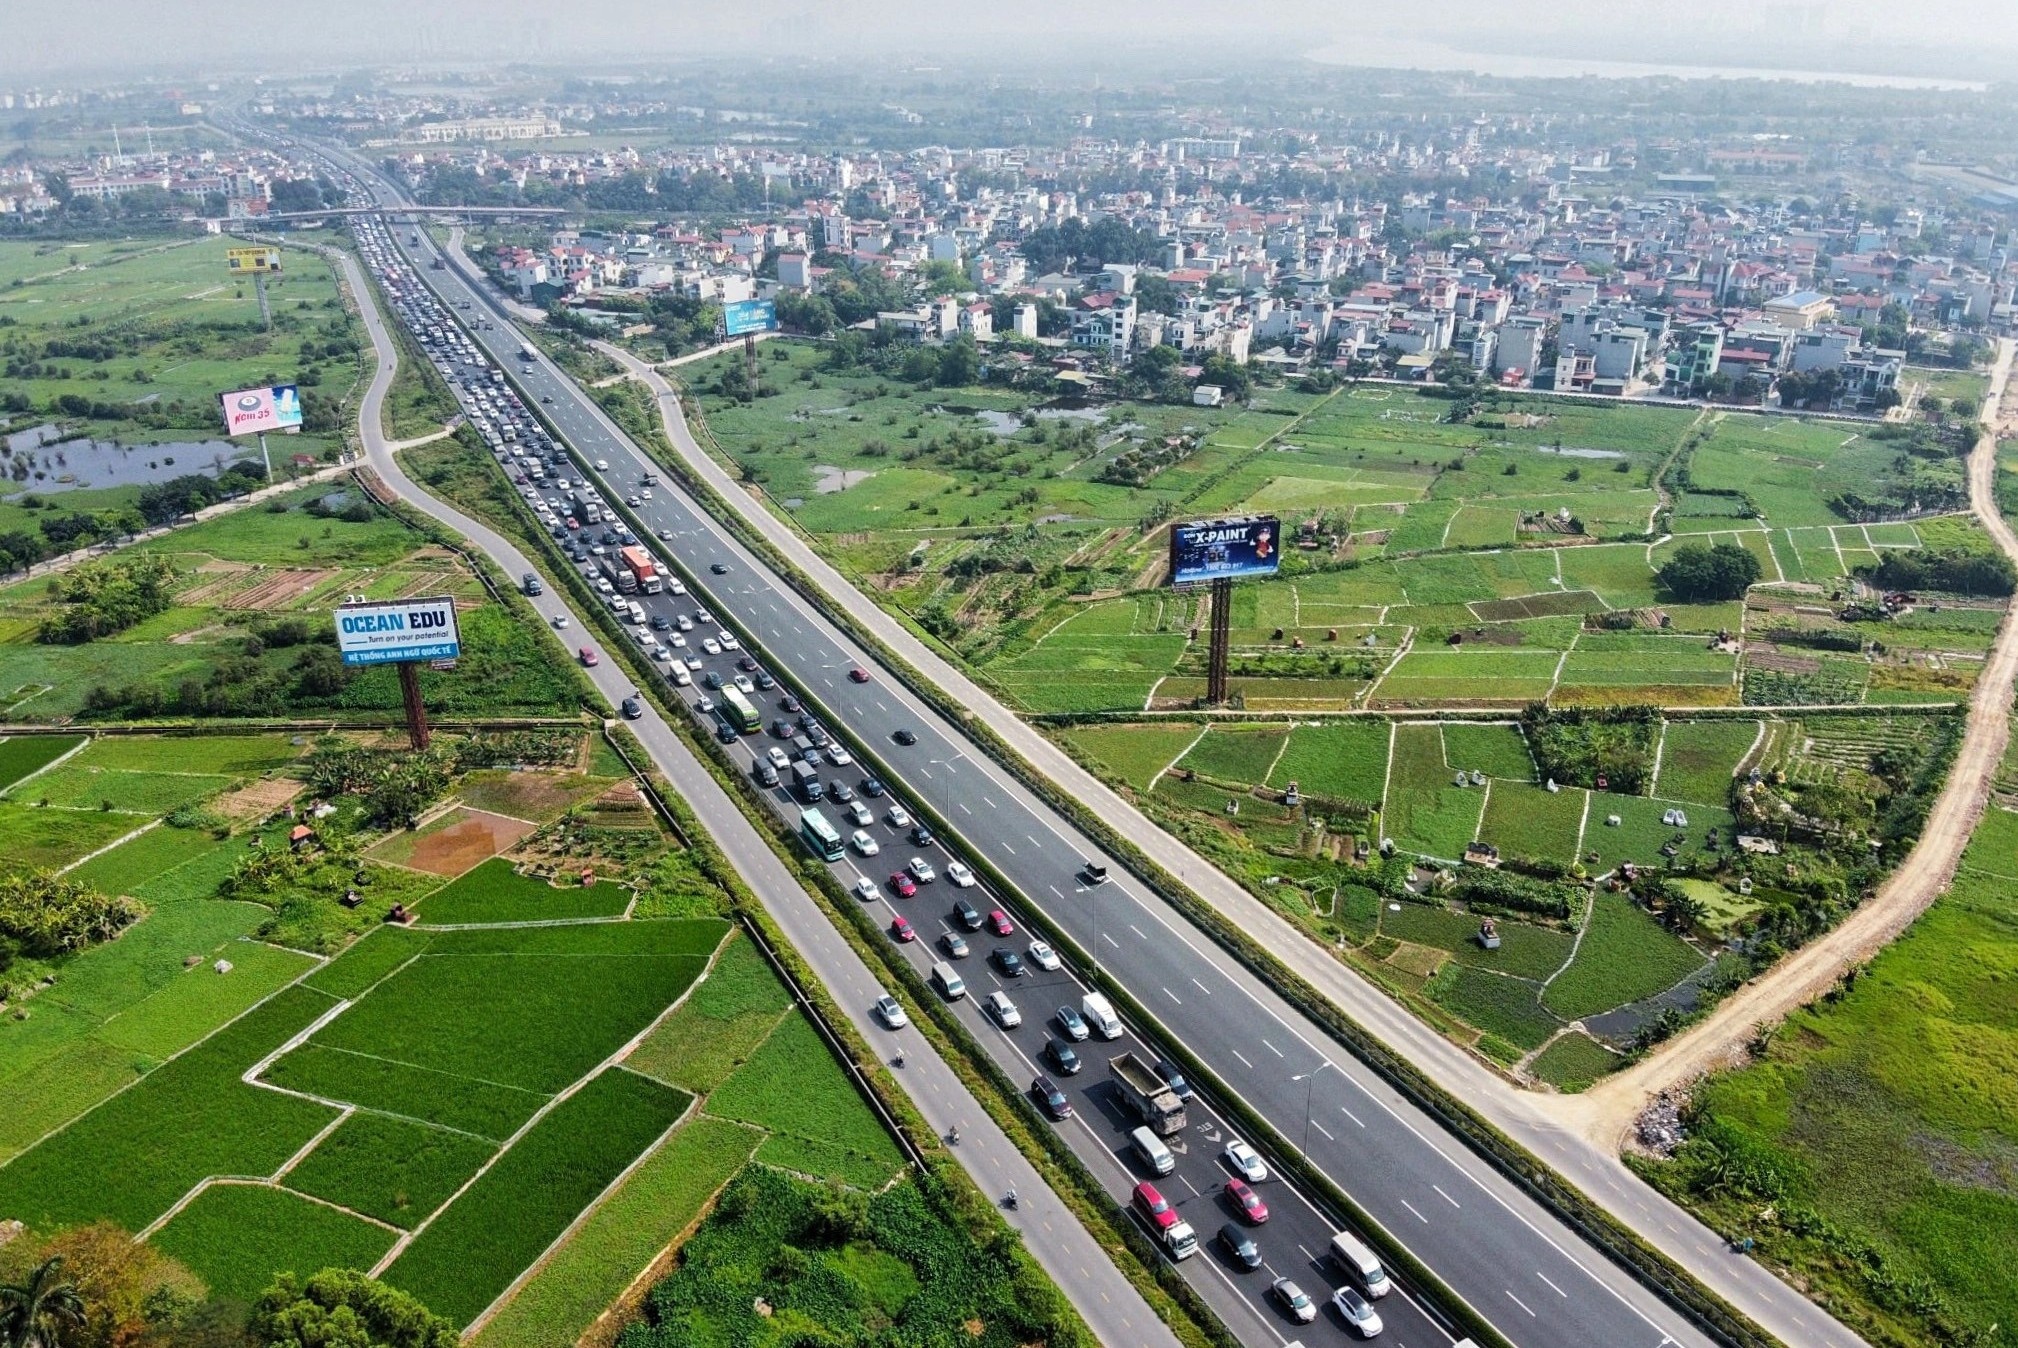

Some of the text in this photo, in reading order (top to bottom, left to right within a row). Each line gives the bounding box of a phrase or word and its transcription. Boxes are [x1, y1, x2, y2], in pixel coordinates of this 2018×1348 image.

[258, 408, 270, 419] 35
[1195, 527, 1248, 543] X-PAINT
[342, 611, 446, 634] OCEAN EDU
[397, 635, 413, 643] your
[415, 631, 449, 641] potential
[360, 650, 386, 660] THỐNG
[387, 651, 403, 659] ANH
[421, 646, 441, 656] QUỐC
[1196, 1122, 1214, 1132] ETC
